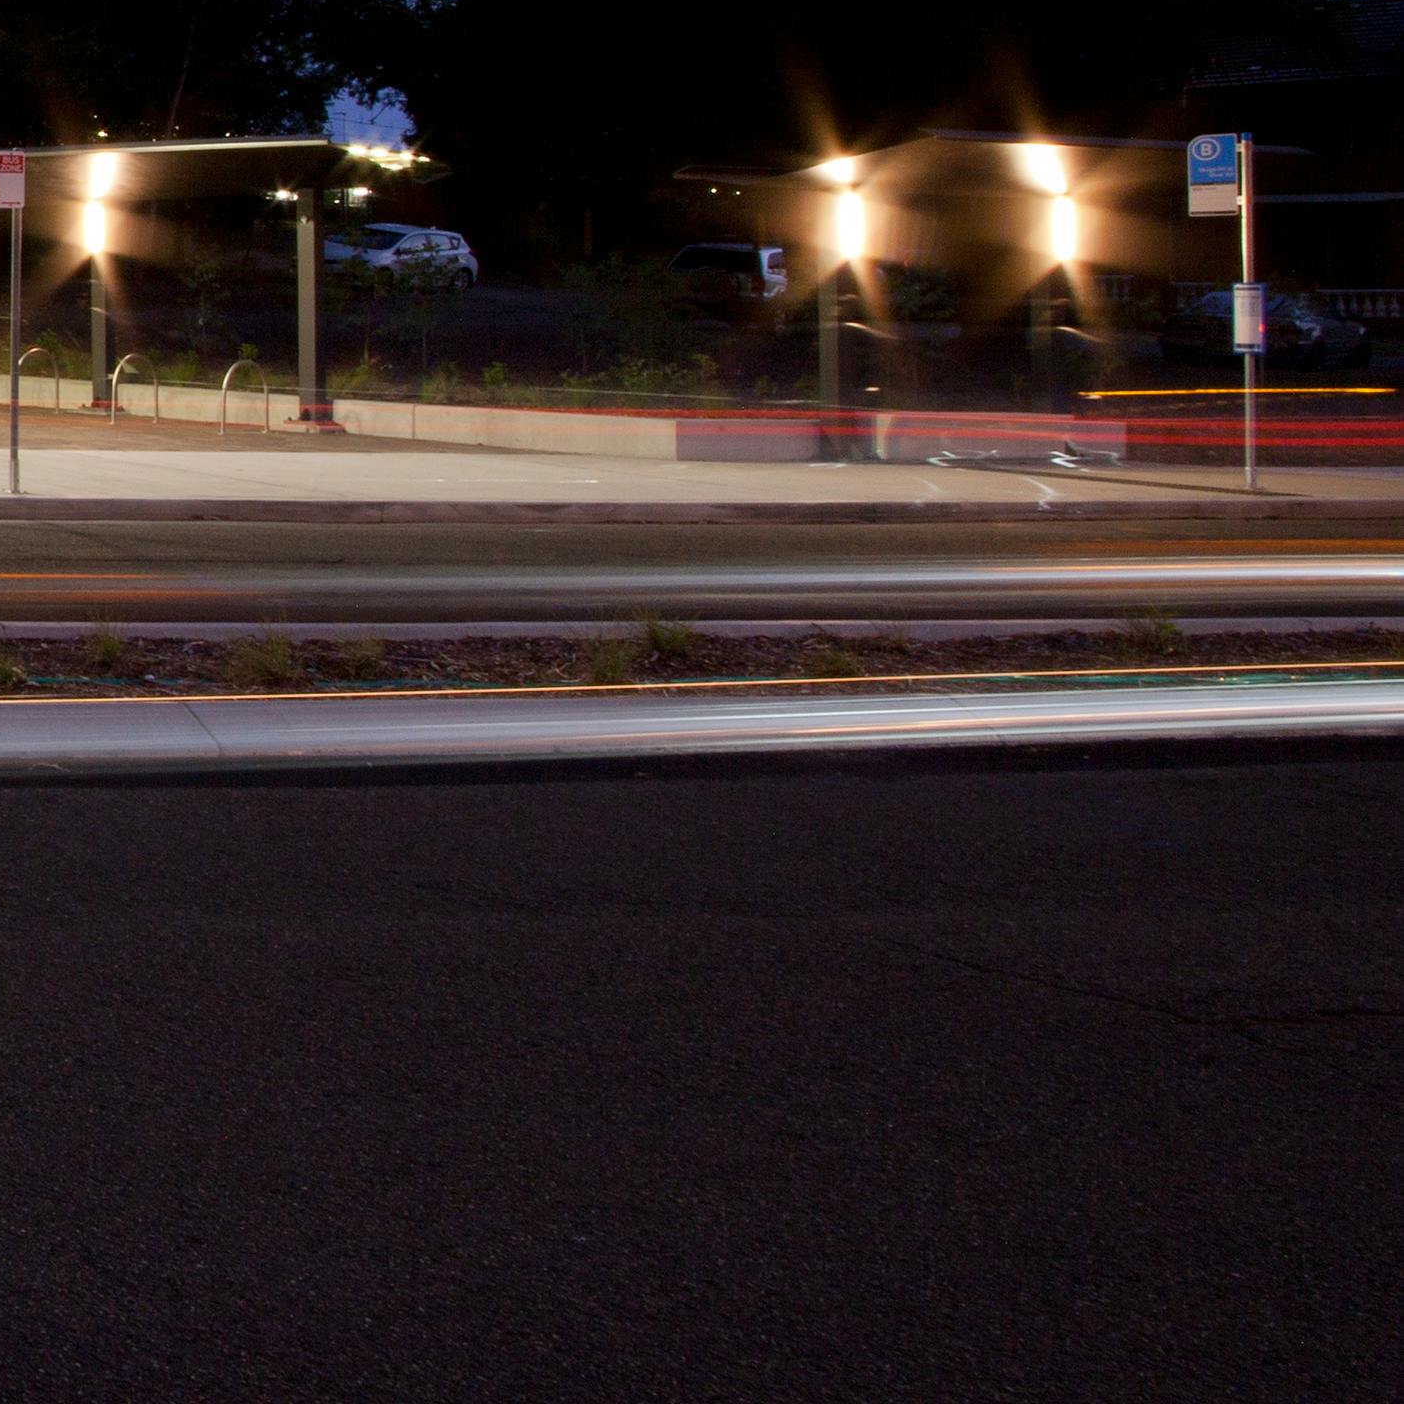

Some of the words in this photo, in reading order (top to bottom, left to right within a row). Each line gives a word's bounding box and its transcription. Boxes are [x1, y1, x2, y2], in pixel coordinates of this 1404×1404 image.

[1200, 143, 1212, 156] B
[2, 156, 20, 164] BUS
[0, 164, 23, 172] ZONE
